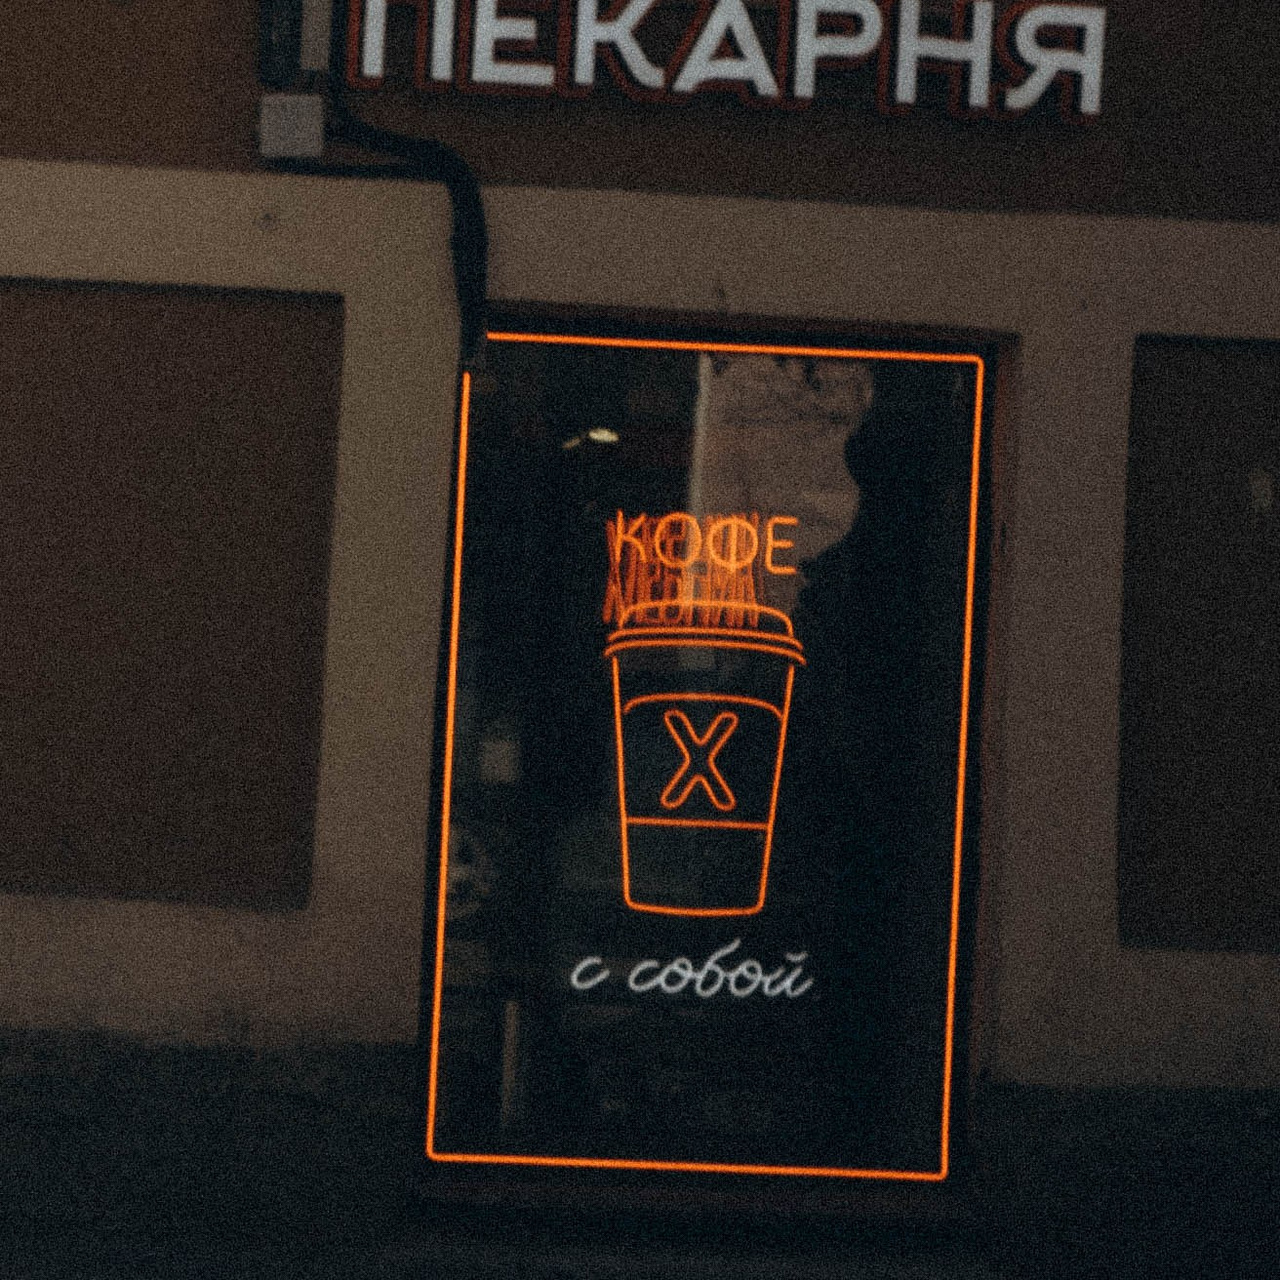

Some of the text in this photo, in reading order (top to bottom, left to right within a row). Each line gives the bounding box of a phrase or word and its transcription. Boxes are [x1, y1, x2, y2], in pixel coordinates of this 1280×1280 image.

[615, 508, 799, 576] КОФЕ
[568, 937, 814, 999] с собой
